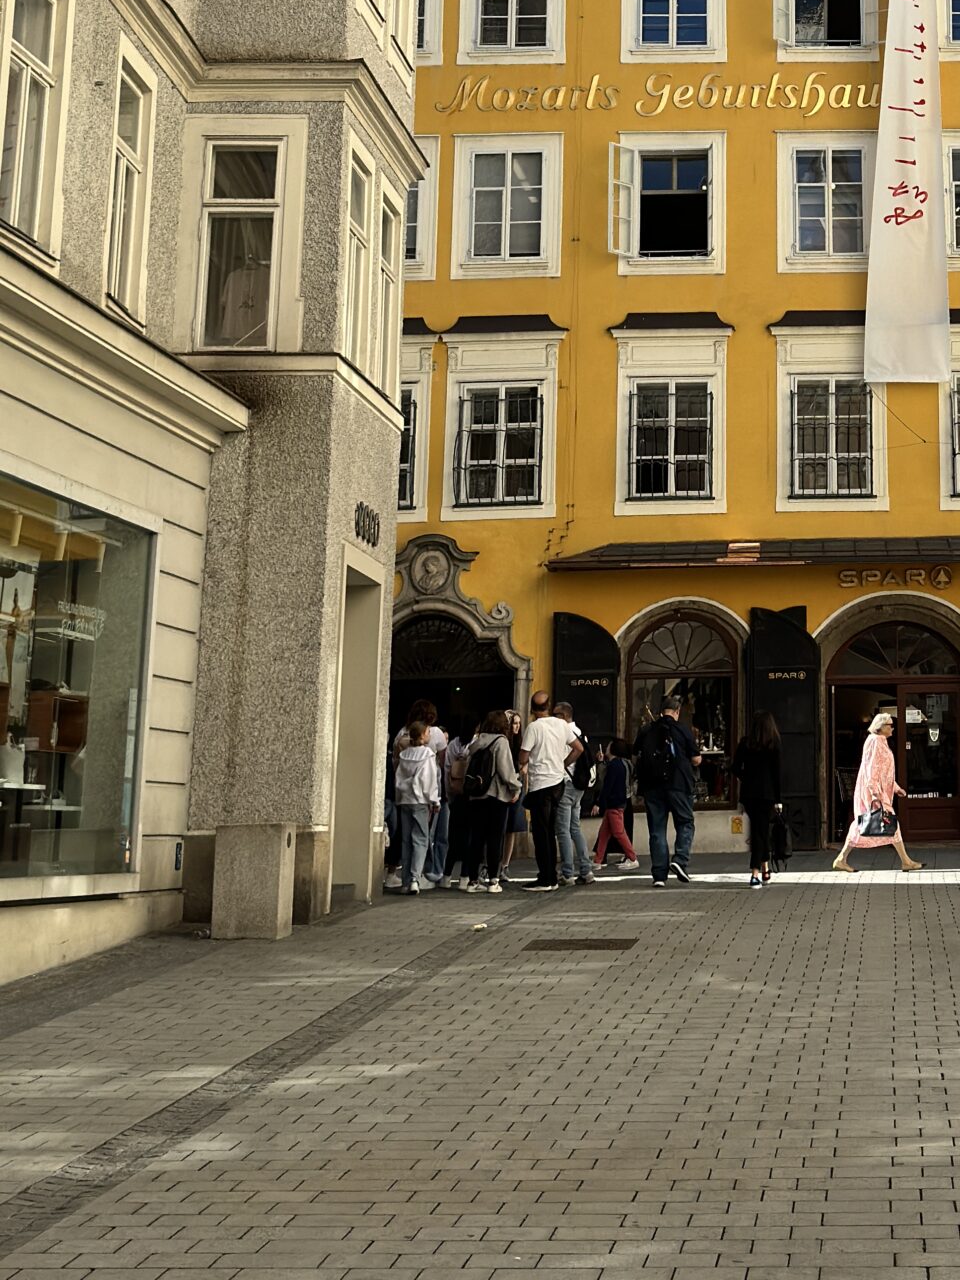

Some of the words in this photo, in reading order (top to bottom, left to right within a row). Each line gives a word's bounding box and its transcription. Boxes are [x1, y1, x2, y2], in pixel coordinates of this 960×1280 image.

[434, 73, 621, 113] Mozarts
[635, 71, 881, 117] Geburtshau
[838, 568, 927, 588] SPAR
[570, 678, 600, 687] SPAR
[768, 672, 797, 680] SPAR
